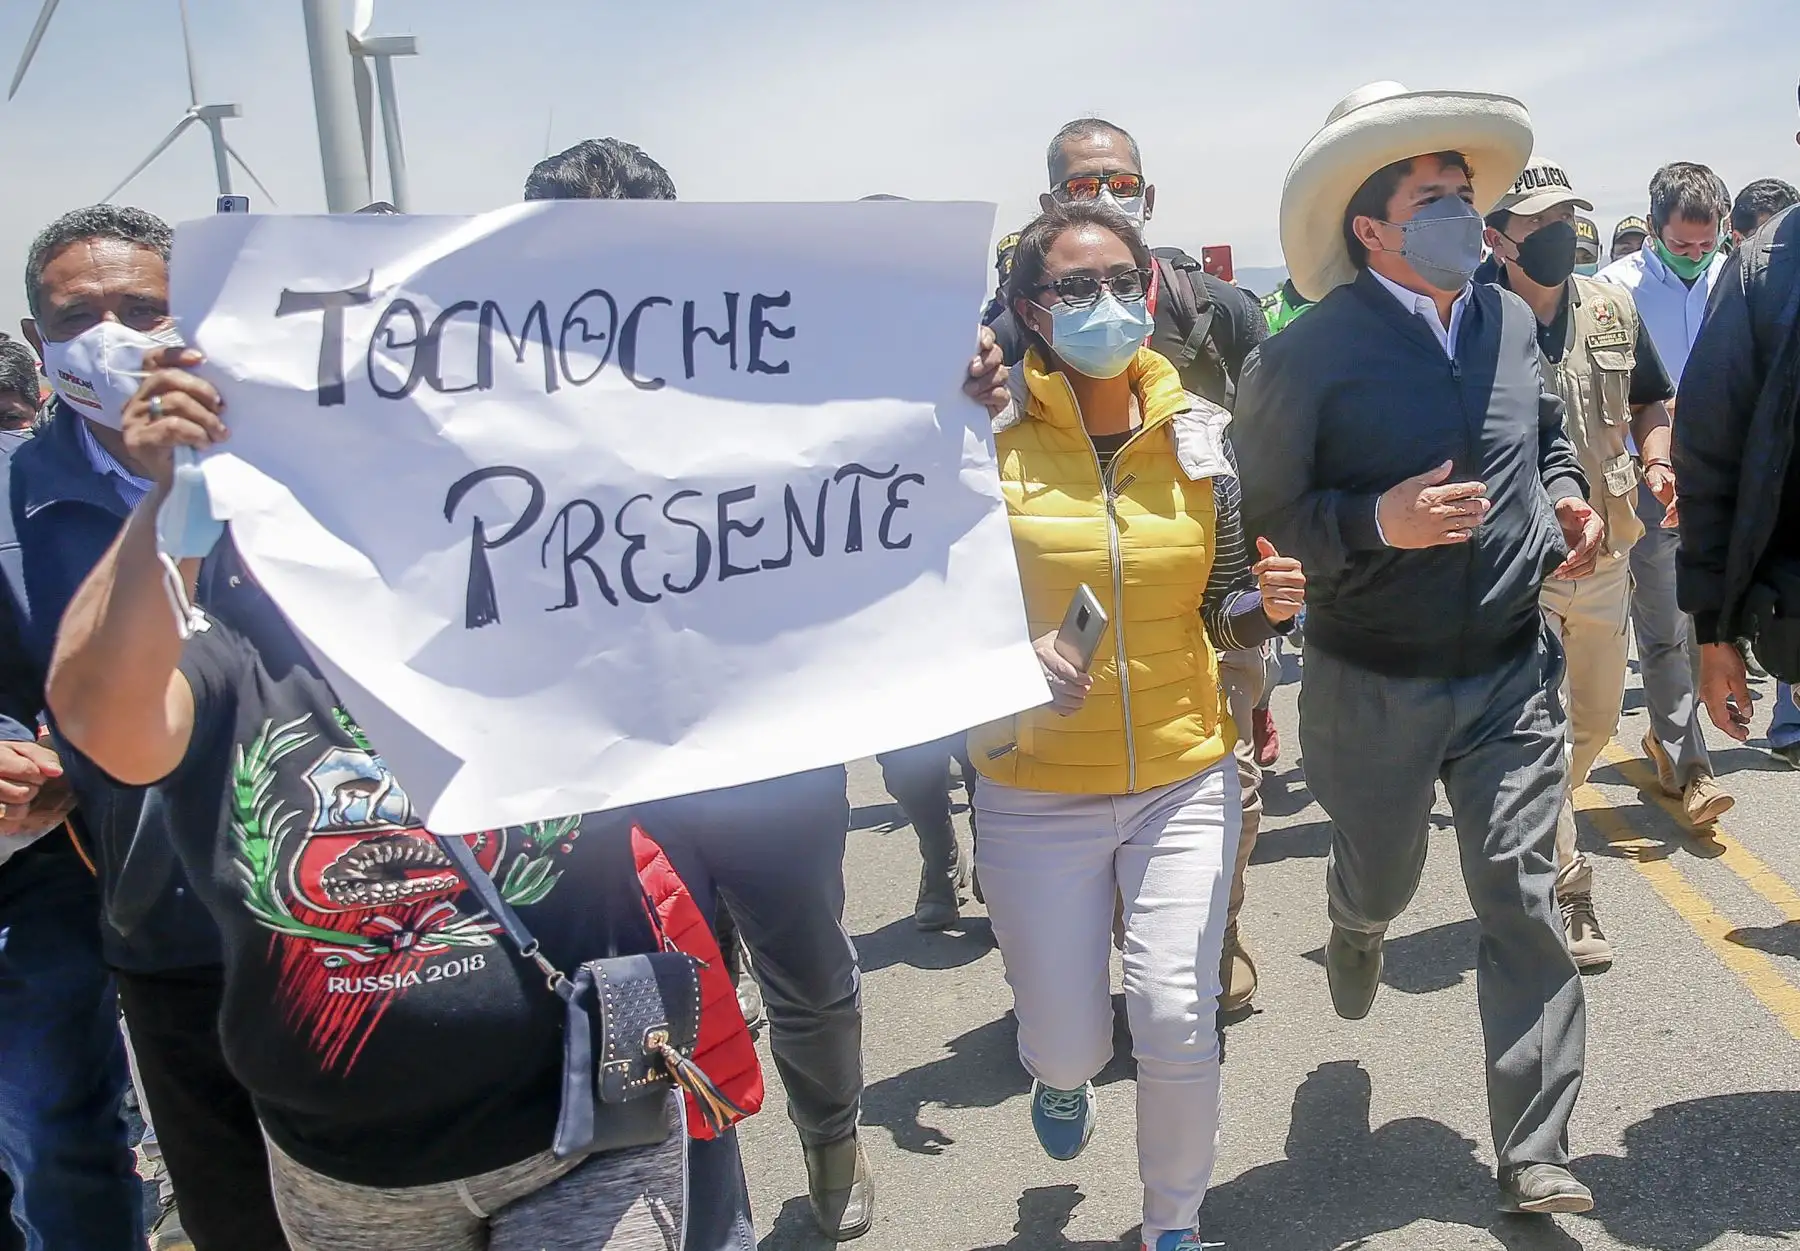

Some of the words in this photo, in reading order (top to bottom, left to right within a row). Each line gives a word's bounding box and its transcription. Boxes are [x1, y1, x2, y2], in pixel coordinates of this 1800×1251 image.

[276, 269, 796, 406] TOCMOCHE
[444, 462, 924, 630] PRESENTE
[327, 969, 423, 994] RUSSIA
[425, 953, 487, 983] 2018
